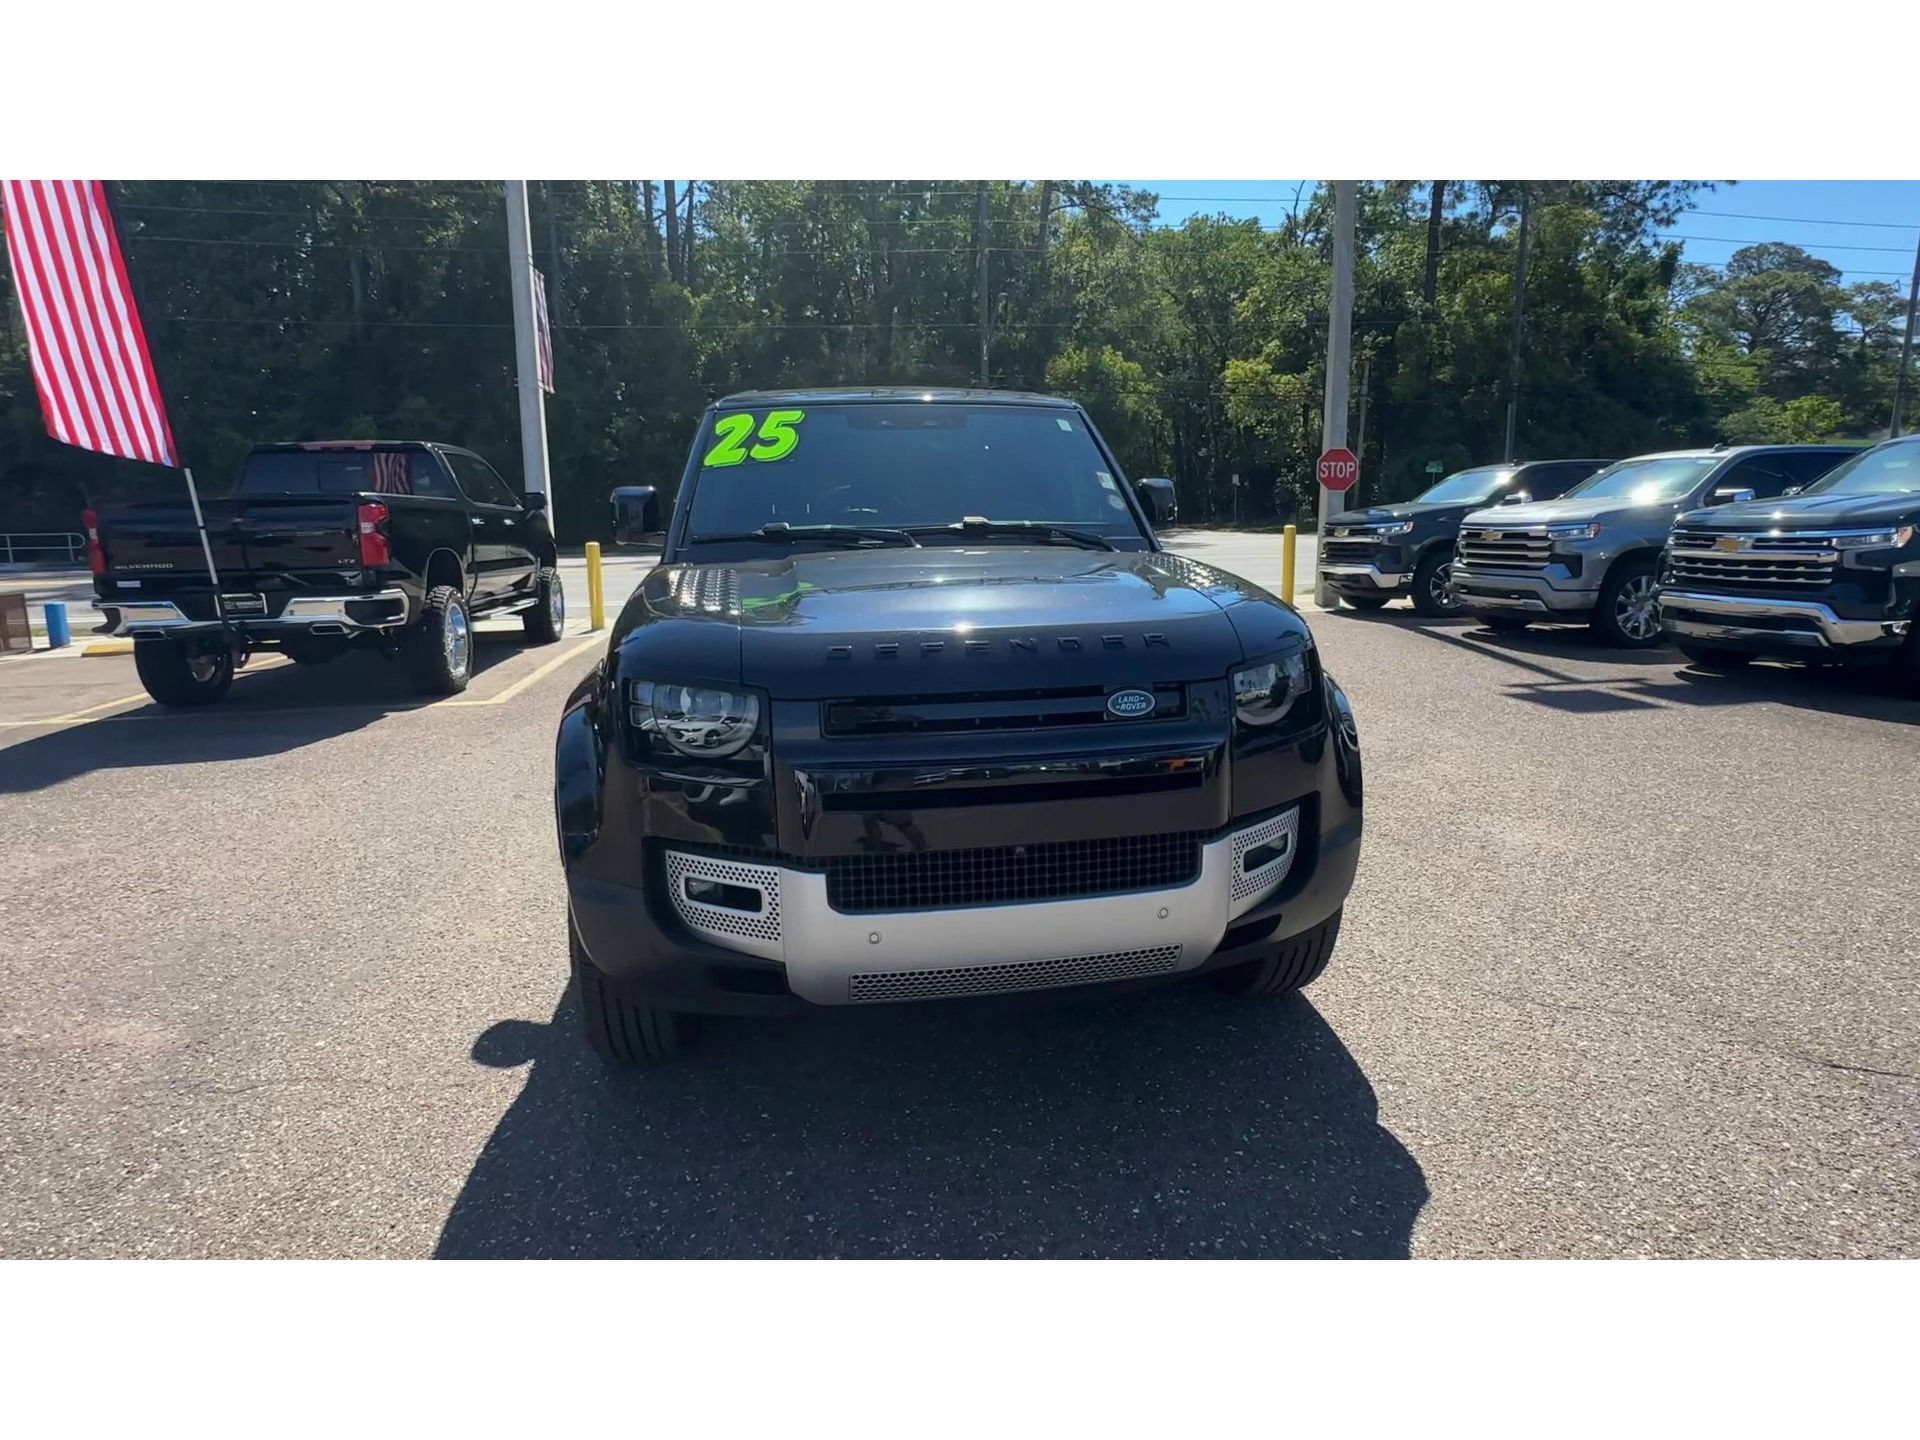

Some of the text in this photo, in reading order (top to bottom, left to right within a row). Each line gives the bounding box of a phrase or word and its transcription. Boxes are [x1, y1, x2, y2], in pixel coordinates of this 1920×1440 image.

[704, 410, 805, 468] 25
[1320, 461, 1355, 478] STOP
[826, 632, 1171, 661] DEFENDER
